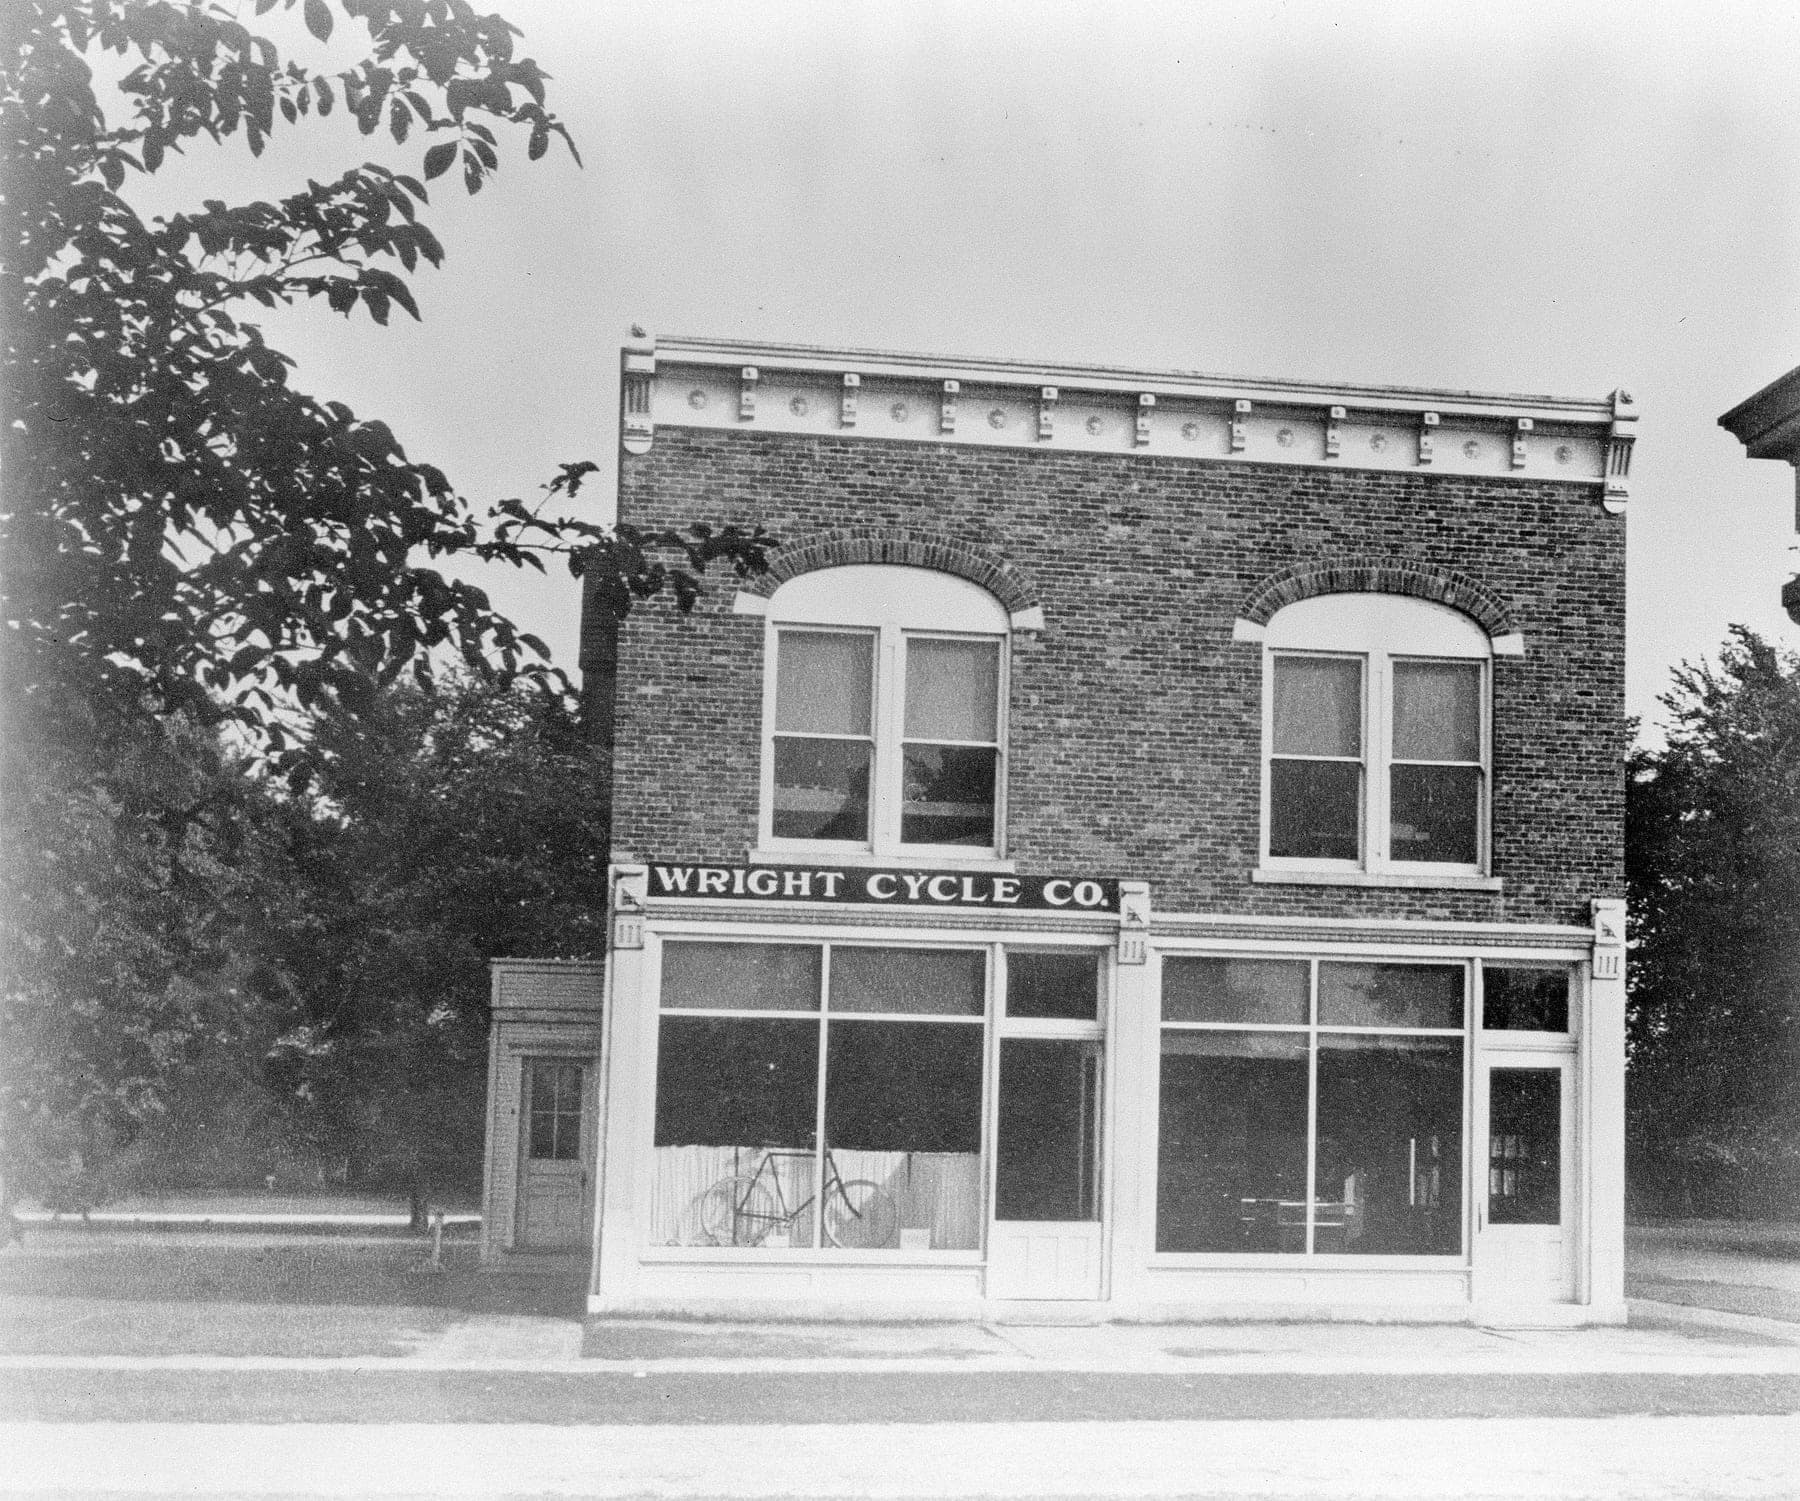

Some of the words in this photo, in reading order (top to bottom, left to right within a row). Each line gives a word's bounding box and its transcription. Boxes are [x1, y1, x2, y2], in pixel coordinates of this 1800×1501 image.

[654, 866, 845, 897] WRIGHT
[866, 873, 1021, 903] CYCLE
[1042, 879, 1109, 907] CO.
